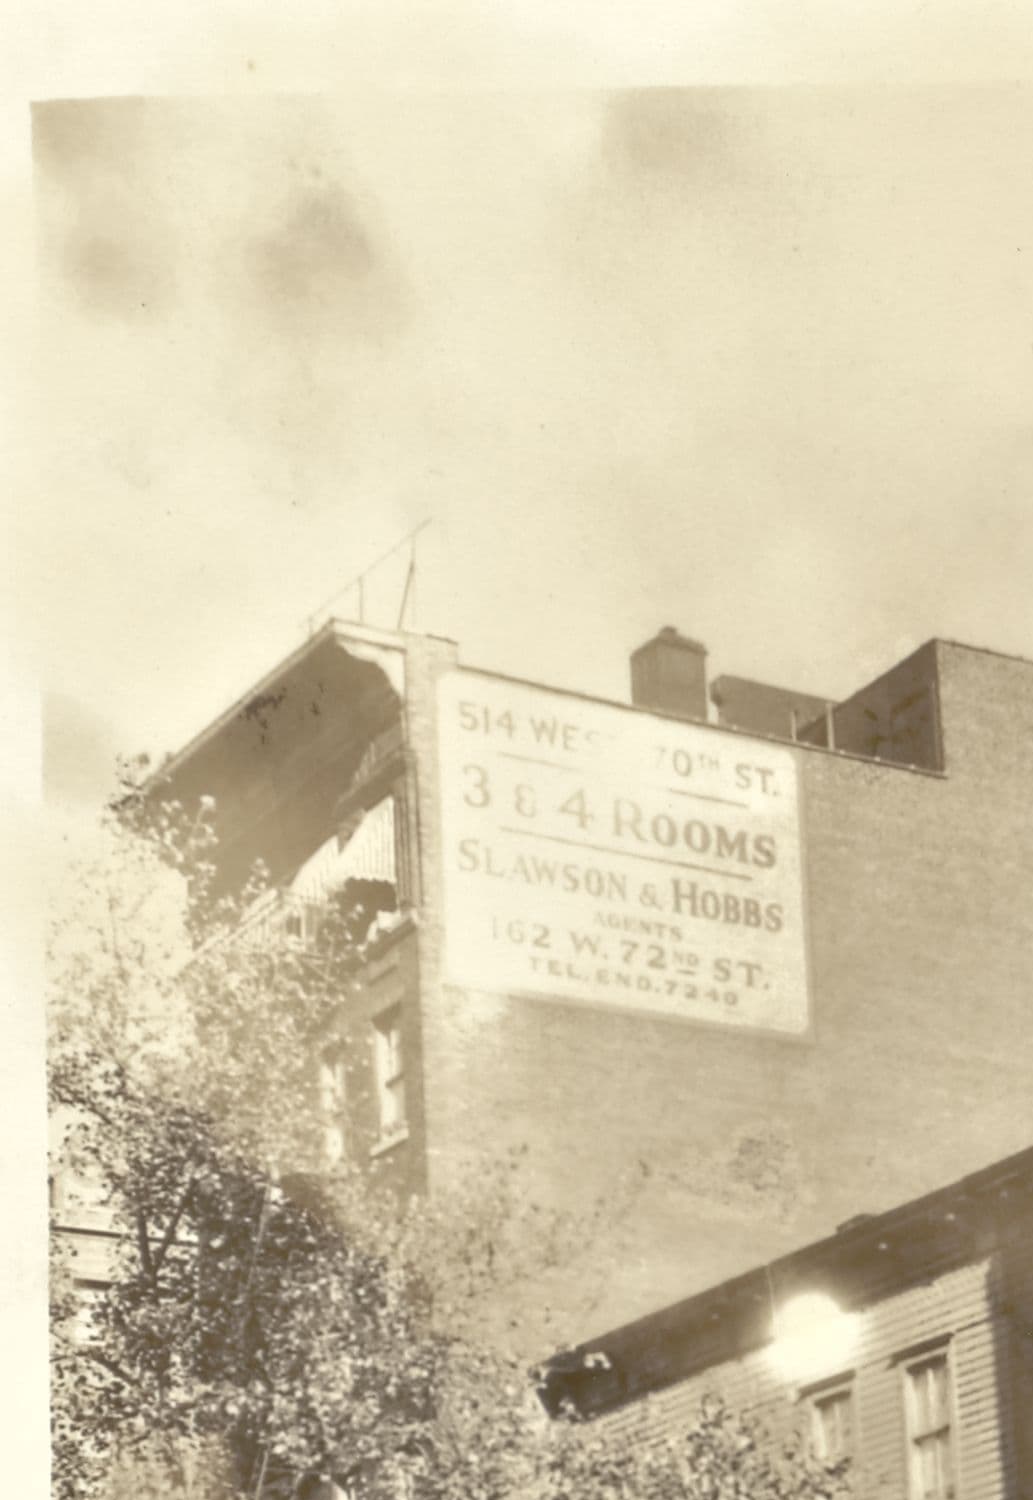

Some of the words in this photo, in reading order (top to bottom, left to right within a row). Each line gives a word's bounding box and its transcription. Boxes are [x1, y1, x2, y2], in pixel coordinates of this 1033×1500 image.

[458, 702, 515, 738] 514
[461, 765, 492, 809] 3
[557, 788, 594, 830] 4
[611, 796, 778, 869] ROOMS
[458, 838, 628, 901] SLAWSON
[638, 882, 664, 911] &
[671, 877, 784, 933] HOBBS
[490, 914, 553, 950] 162
[569, 929, 609, 960] W.
[713, 956, 771, 991] ST.
[595, 909, 684, 943] AGENTS
